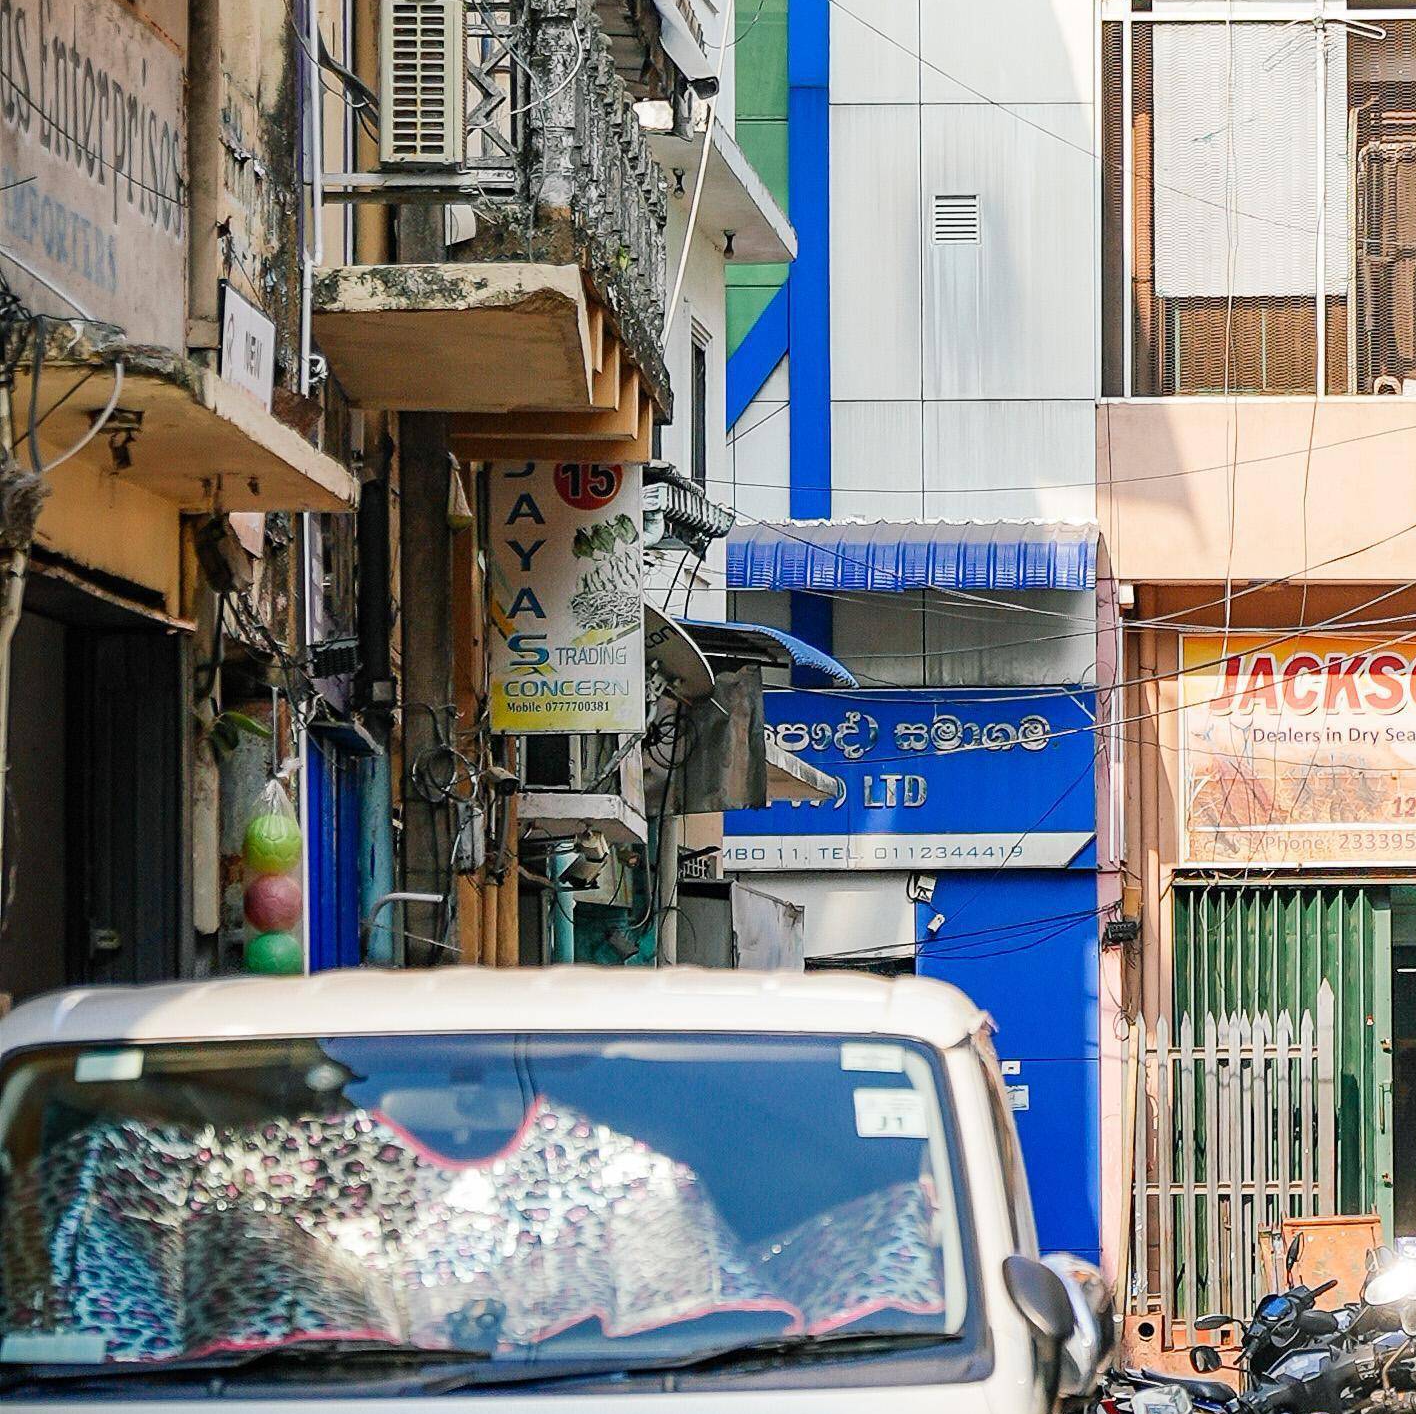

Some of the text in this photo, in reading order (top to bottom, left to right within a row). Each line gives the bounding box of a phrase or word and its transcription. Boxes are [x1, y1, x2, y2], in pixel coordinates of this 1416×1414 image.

[558, 463, 616, 499] 15
[554, 647, 627, 666] TRADING
[504, 680, 630, 698] CONCERN
[506, 701, 610, 713] Mobile 0777700381
[895, 715, 1050, 750] සමාගම
[1253, 728, 1320, 743] Dealers
[1326, 727, 1342, 742] in
[1349, 728, 1380, 745] Dry
[1385, 728, 1416, 742] Sea
[863, 775, 928, 808] LTD
[873, 846, 1023, 860] 0112344419
